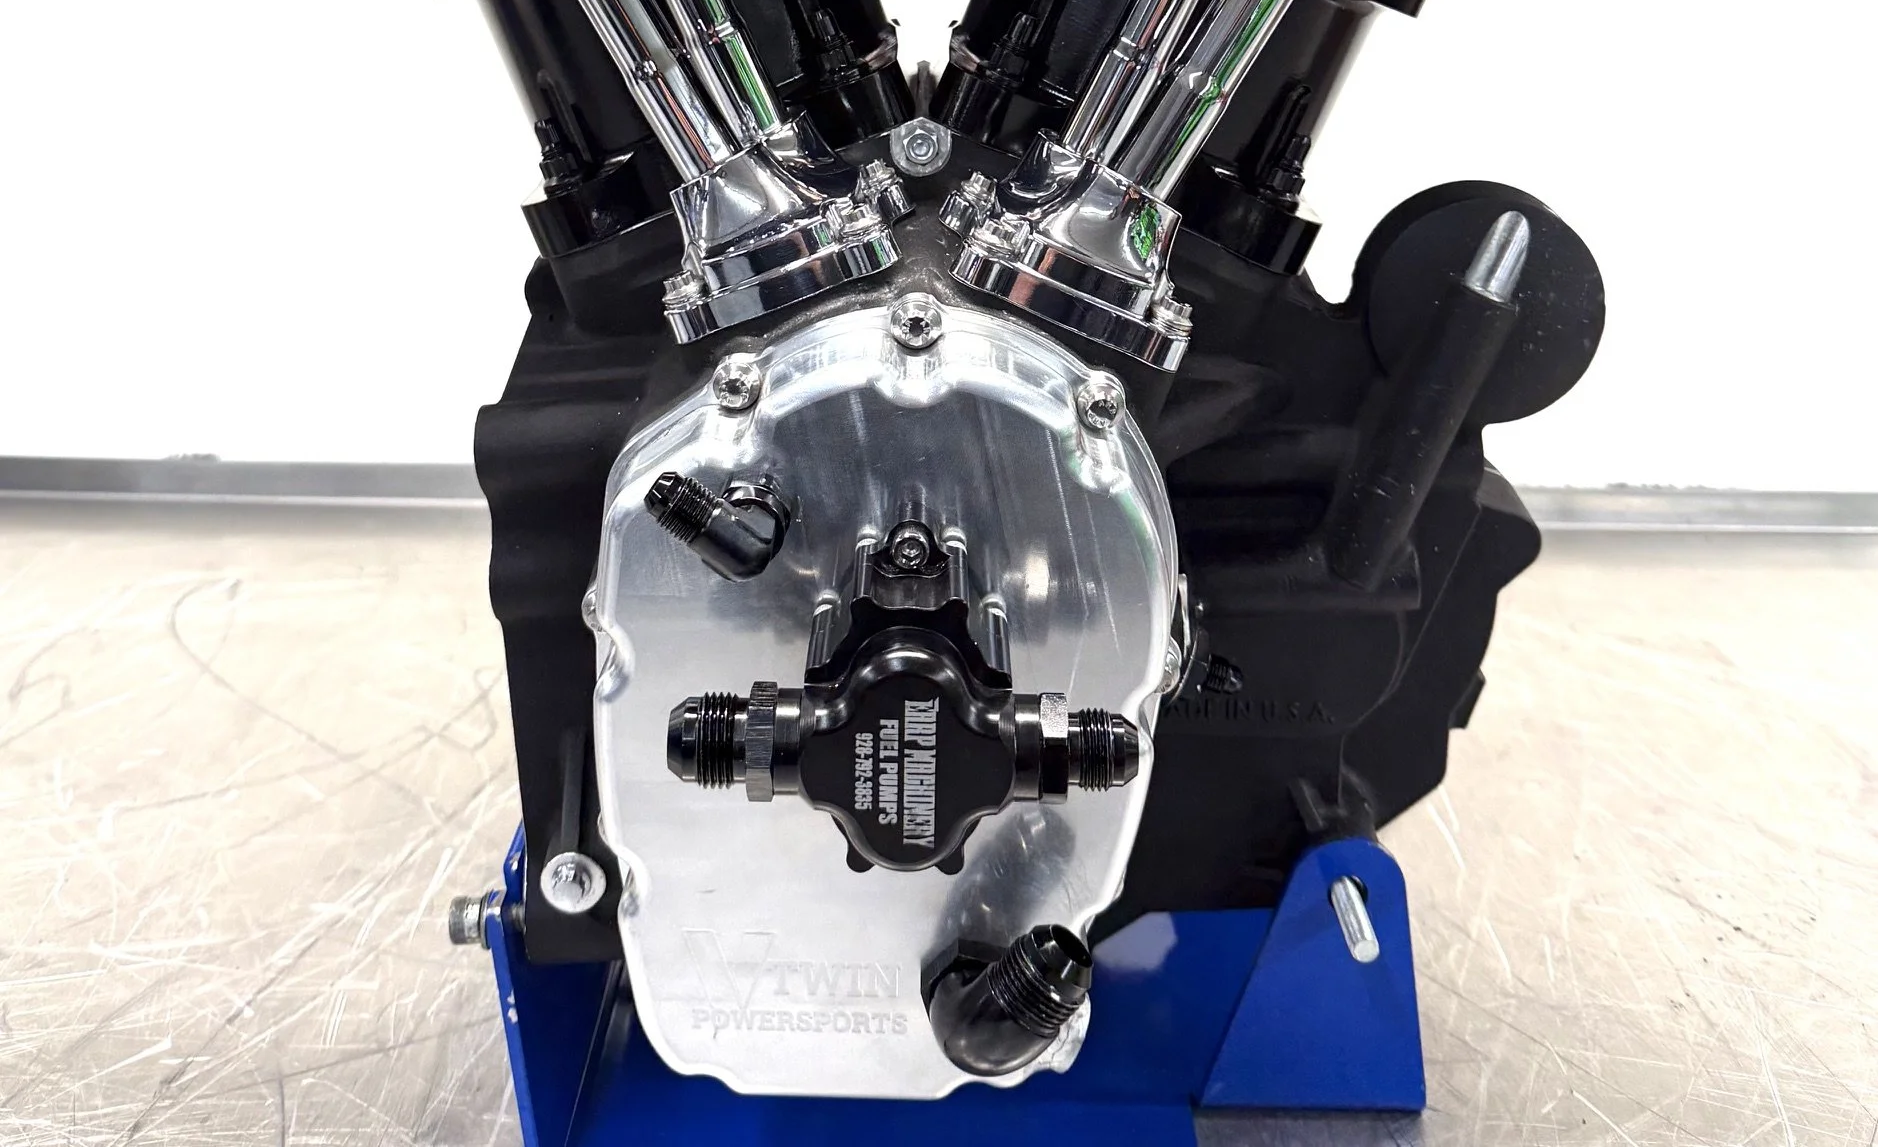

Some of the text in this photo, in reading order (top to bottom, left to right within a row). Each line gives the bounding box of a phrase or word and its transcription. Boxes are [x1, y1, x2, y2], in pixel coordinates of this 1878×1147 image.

[855, 732, 874, 810] 928-792-3835
[878, 719, 899, 825] FUEL PUMPS
[903, 697, 939, 848] EARP MACHINERY
[693, 1008, 909, 1034] POWERSPORTS
